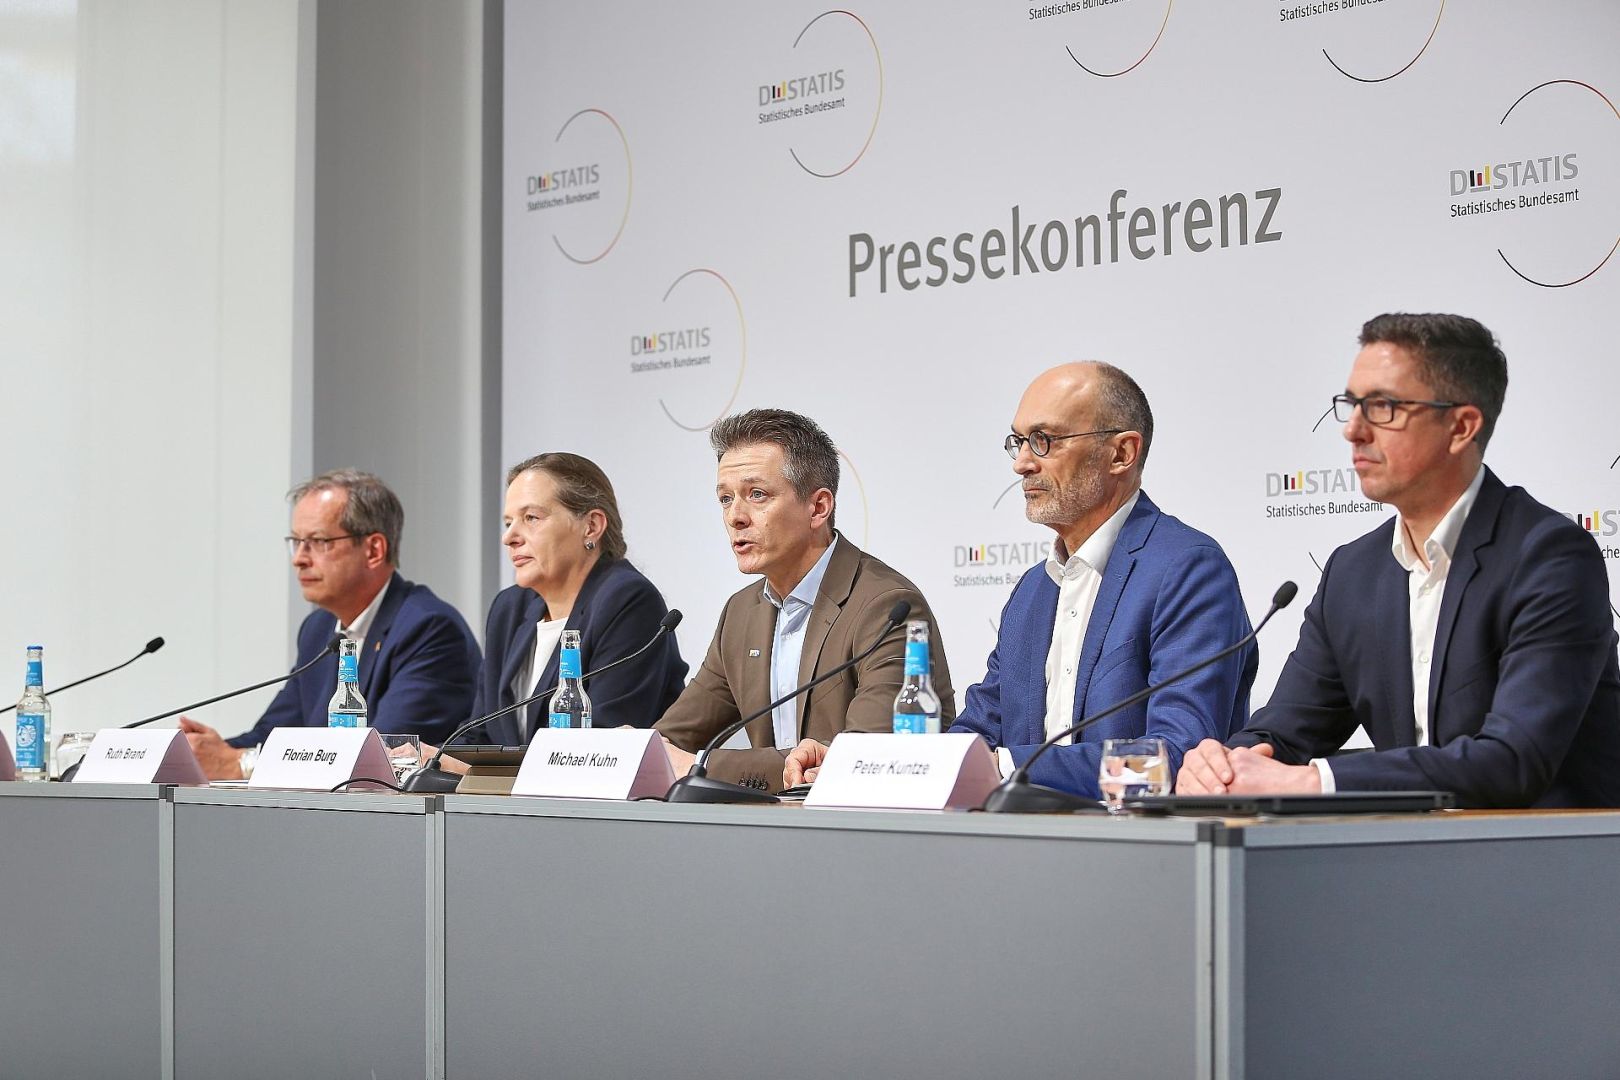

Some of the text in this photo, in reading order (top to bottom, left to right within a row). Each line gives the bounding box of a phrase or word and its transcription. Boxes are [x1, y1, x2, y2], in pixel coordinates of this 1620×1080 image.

[1028, 1, 1081, 20] Statistisches
[1279, 1, 1339, 22] Statistisches
[758, 97, 845, 124] Statistisches Bundesamt
[1450, 188, 1580, 218] Statistisches Bundesamt
[849, 187, 1283, 298] Pressekonferenz
[1266, 500, 1384, 518] Statistisches Bundesamt
[953, 575, 1003, 588] Statistisches
[104, 747, 147, 760] Ruth Brand
[282, 748, 338, 766] Florian Burg
[547, 751, 618, 768] Michael Kuhn
[852, 759, 930, 776] Peter Kuntze
